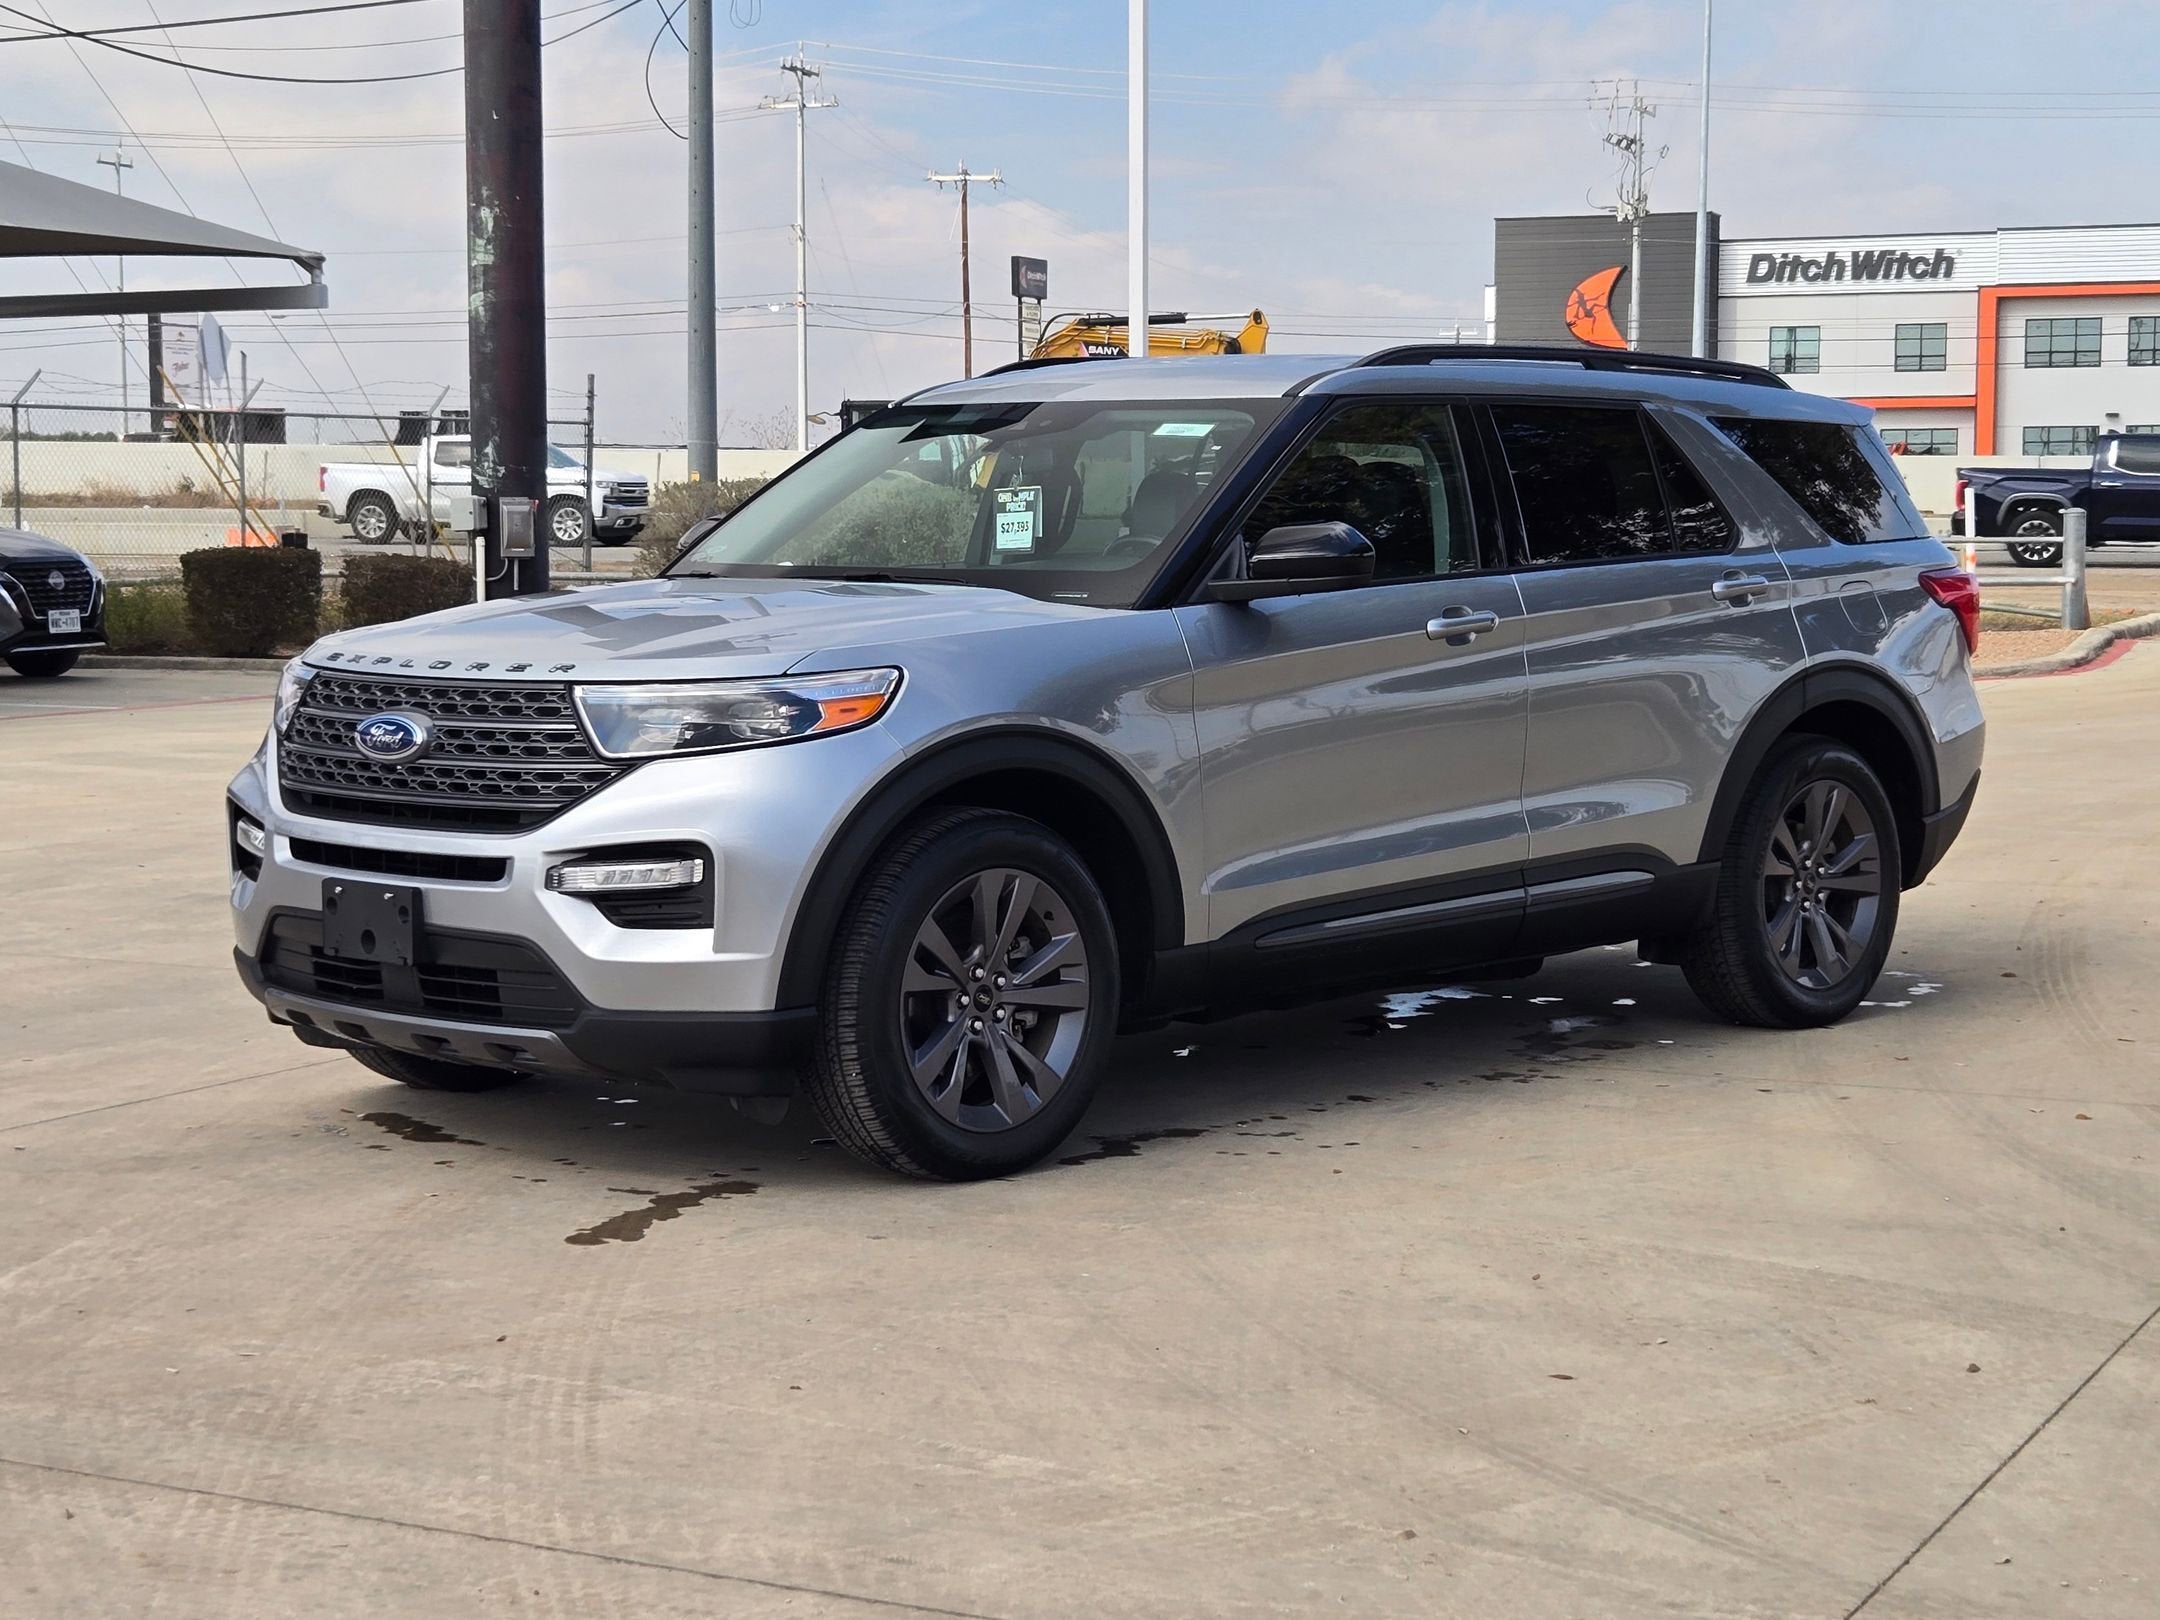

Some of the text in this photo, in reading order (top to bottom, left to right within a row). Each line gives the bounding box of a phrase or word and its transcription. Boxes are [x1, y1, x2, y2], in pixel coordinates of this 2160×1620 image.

[1746, 249, 1955, 283] Ditch Witch
[1088, 345, 1120, 356] SANY
[326, 652, 577, 674] EXPLORER
[366, 723, 405, 746] Ford
